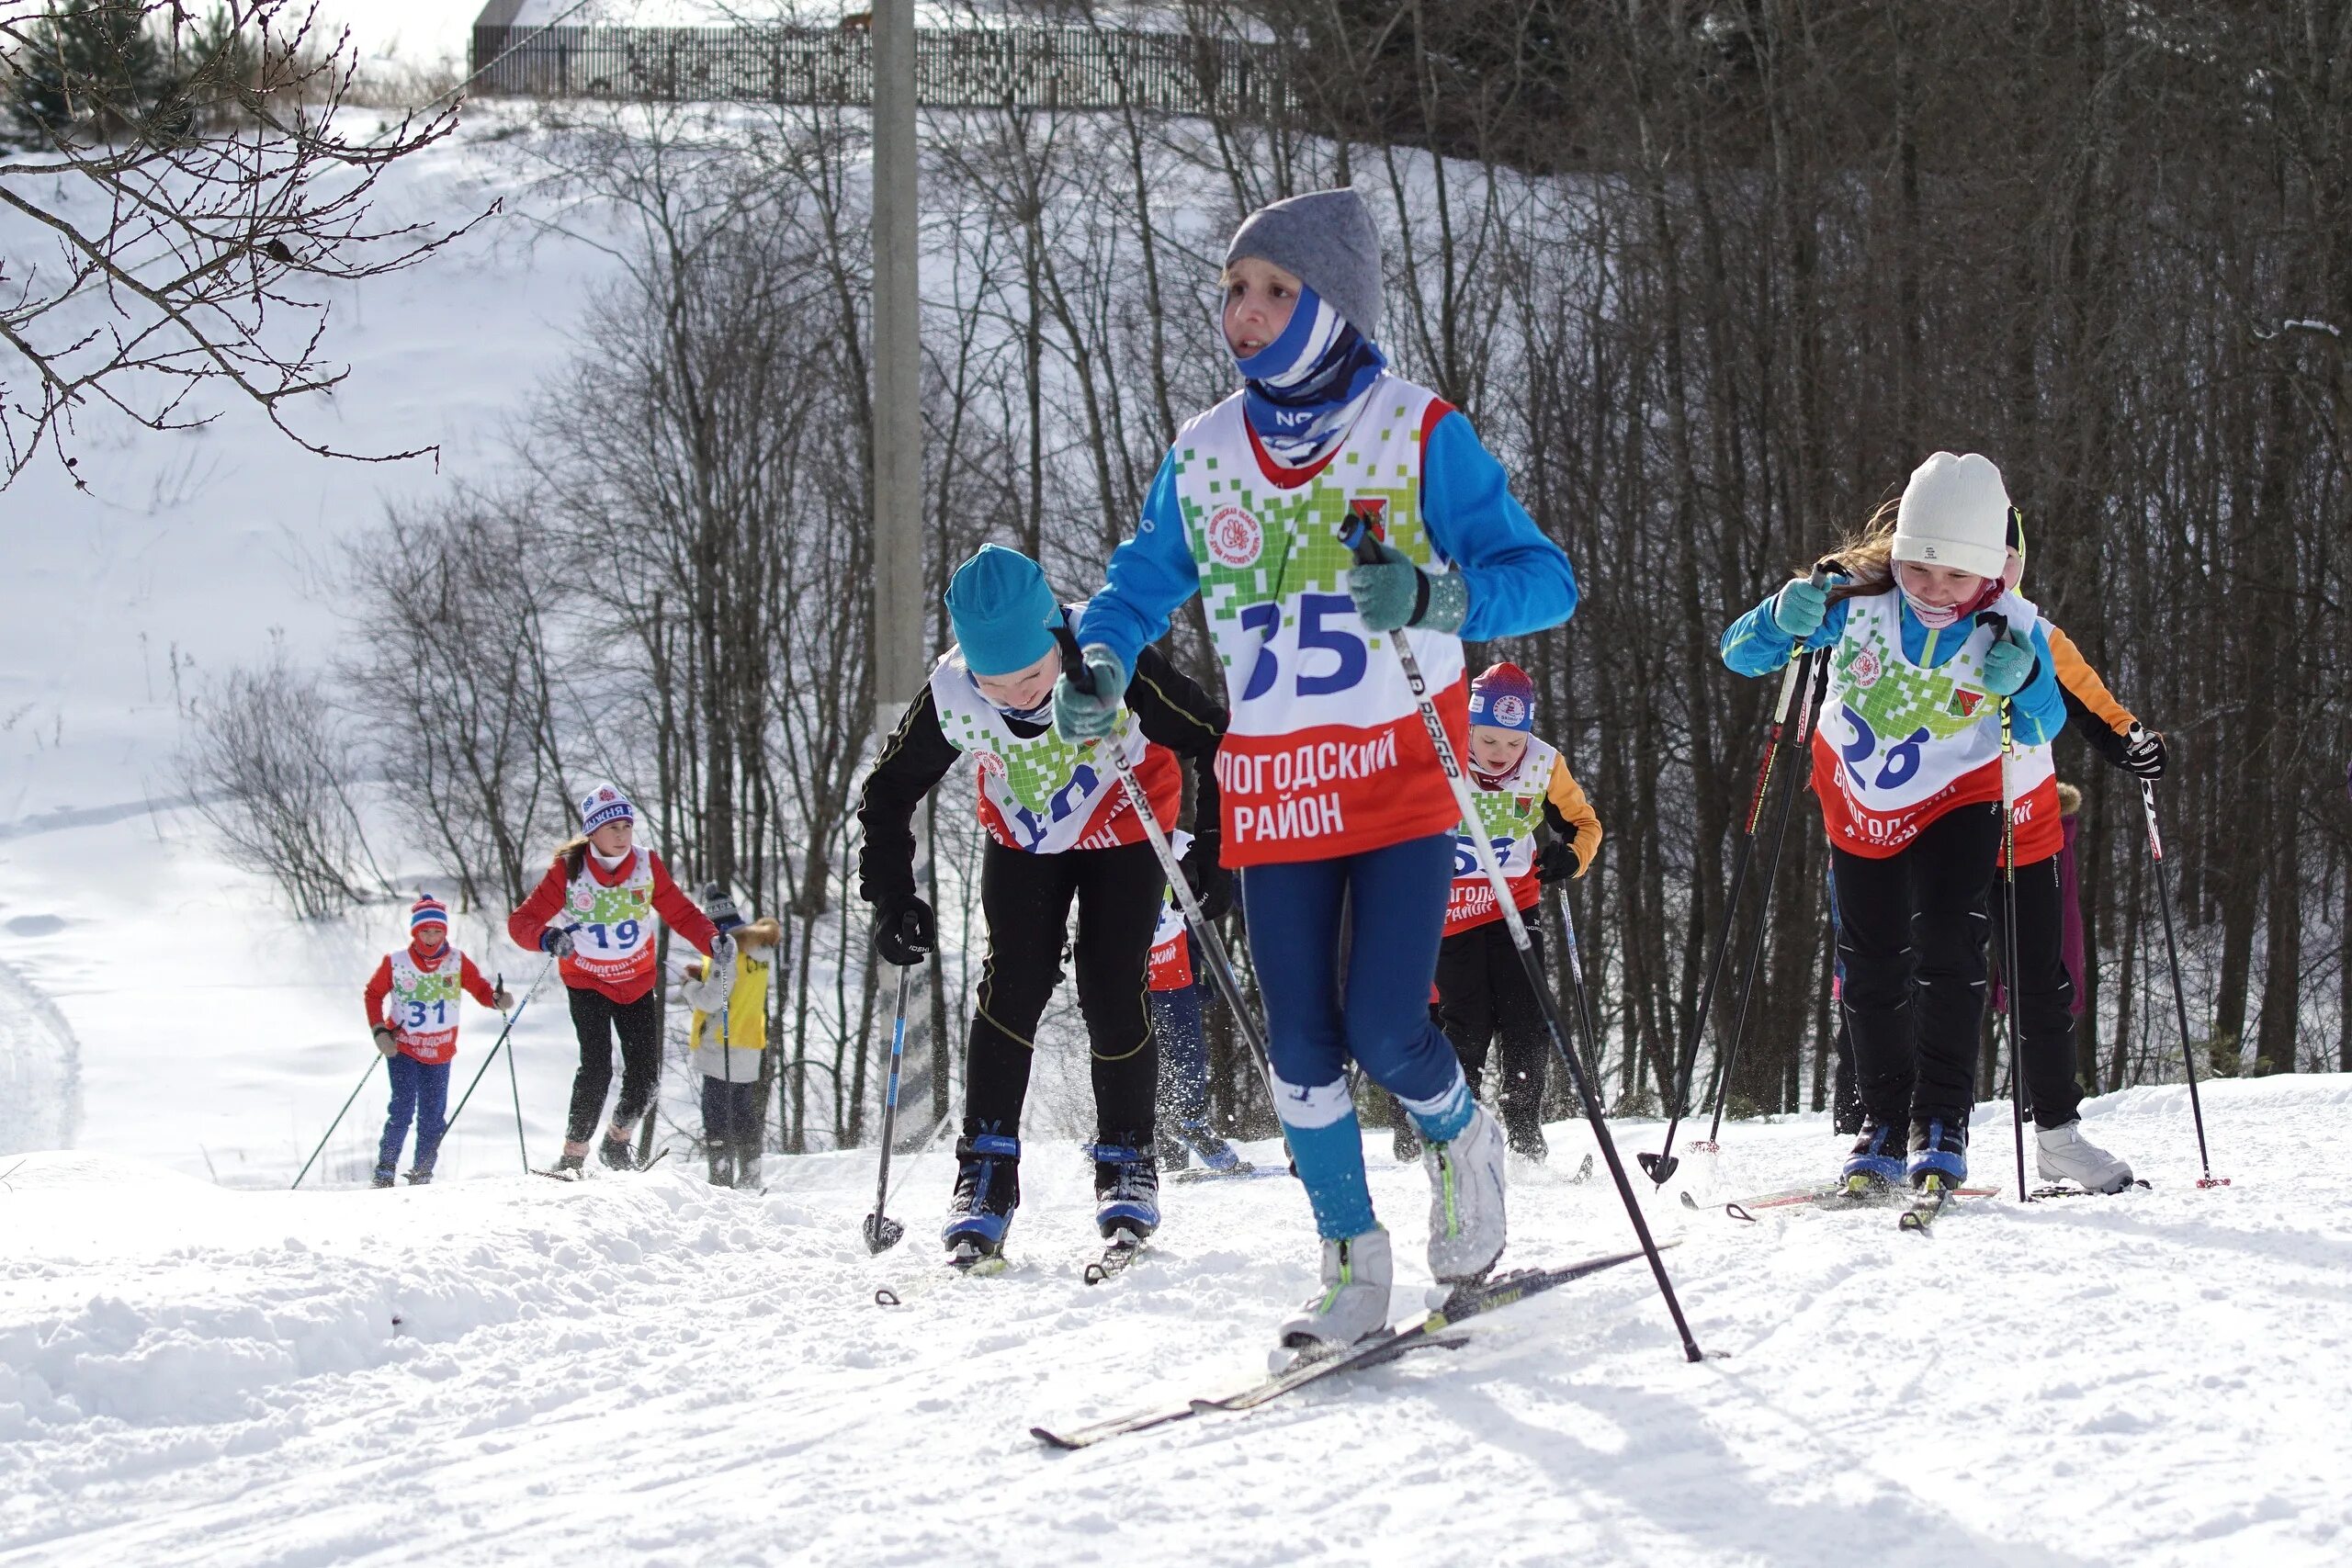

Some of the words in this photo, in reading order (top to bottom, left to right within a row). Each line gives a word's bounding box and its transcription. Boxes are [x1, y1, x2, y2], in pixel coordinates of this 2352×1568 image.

[1241, 593, 1368, 701] 35
[1841, 704, 1929, 791] 26
[1234, 792, 1344, 843] РАЙОН
[588, 919, 640, 950] 19
[408, 998, 445, 1028] 31
